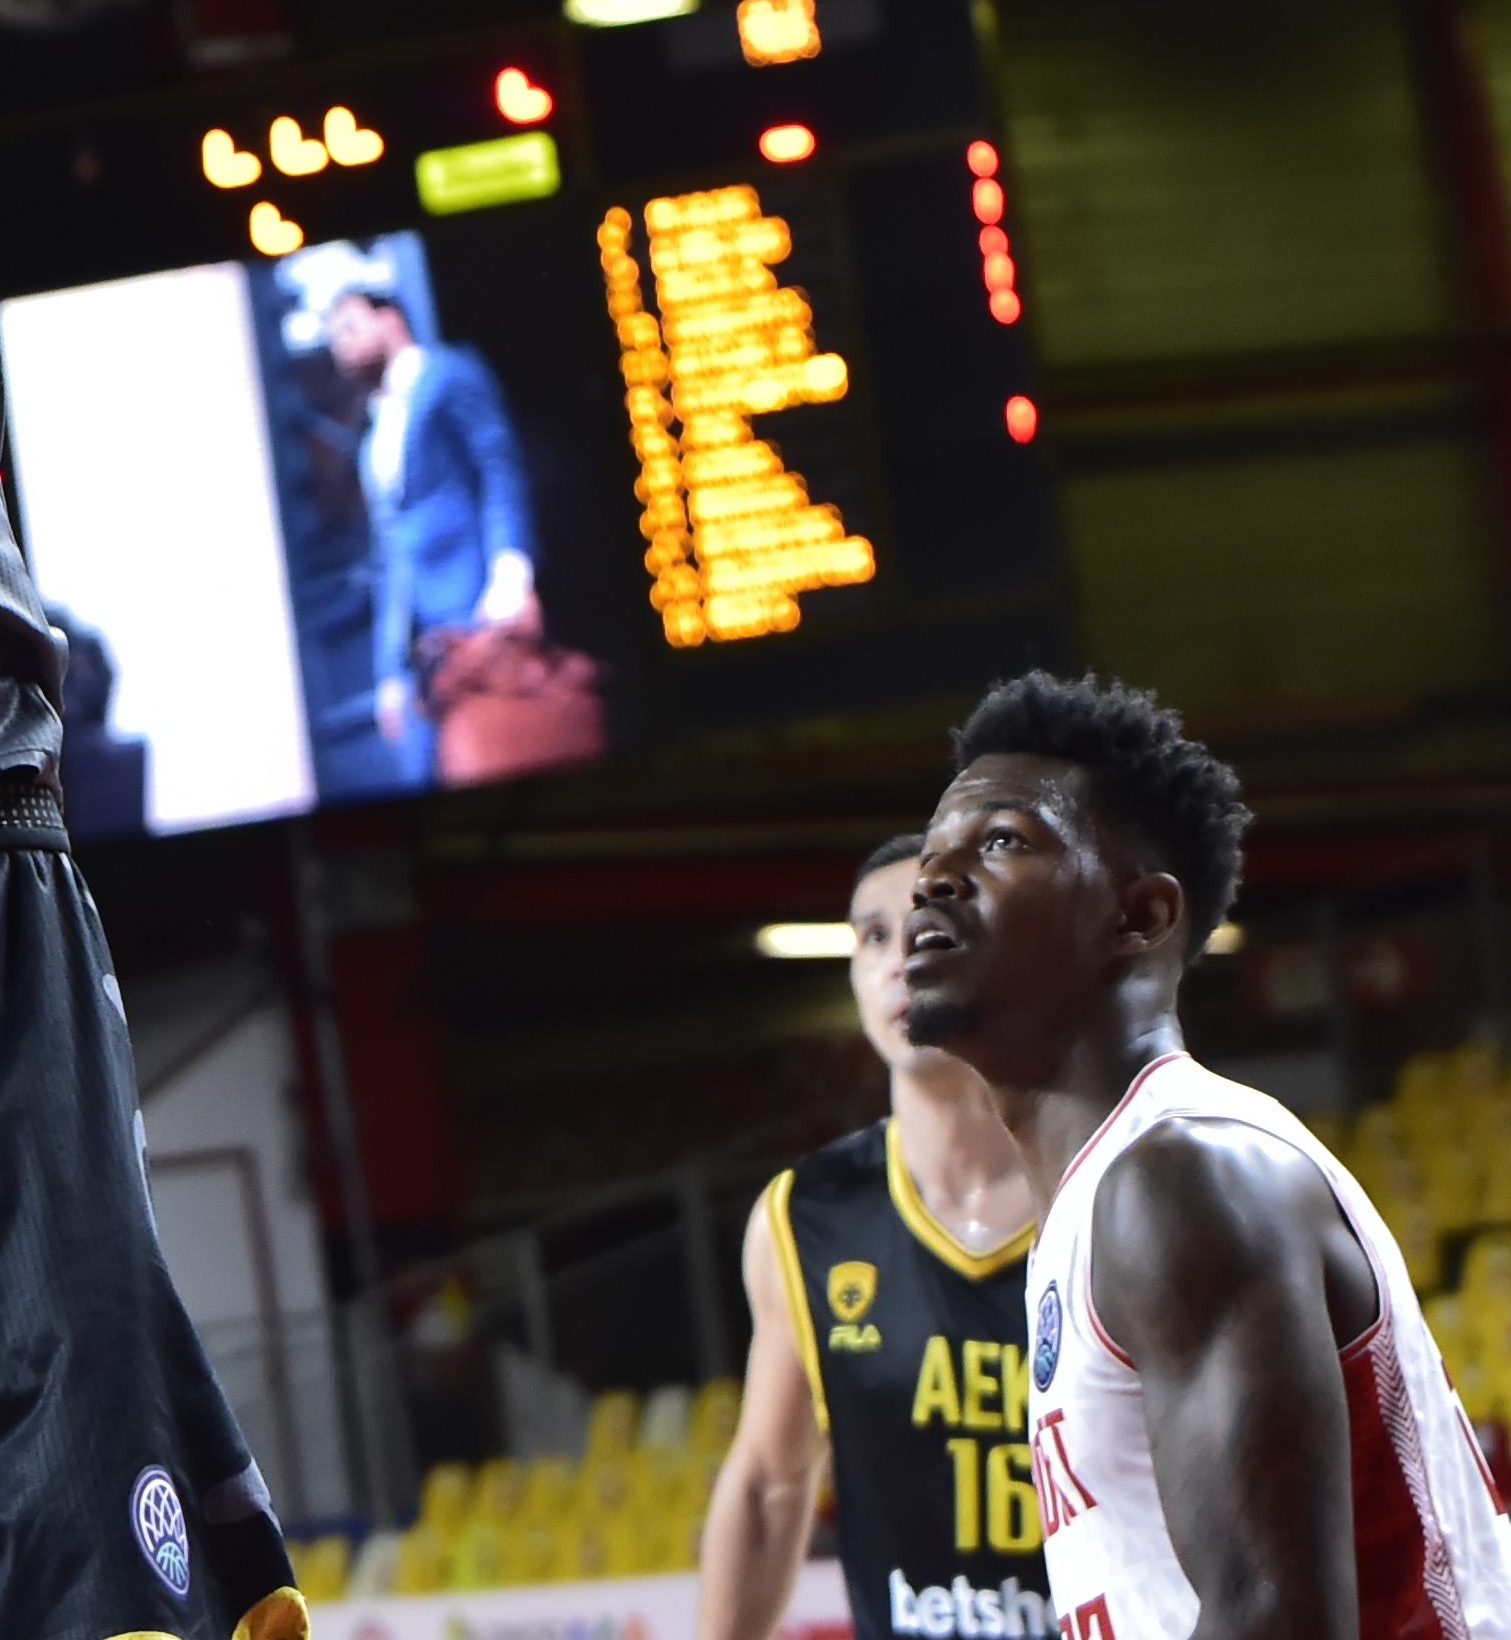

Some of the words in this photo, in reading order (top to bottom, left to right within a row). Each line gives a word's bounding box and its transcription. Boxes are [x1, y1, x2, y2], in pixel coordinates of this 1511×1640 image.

[828, 1324, 882, 1352] FILA
[911, 1334, 1030, 1432] AEK
[945, 1438, 1044, 1553] 16
[889, 1567, 1057, 1640] betsh
